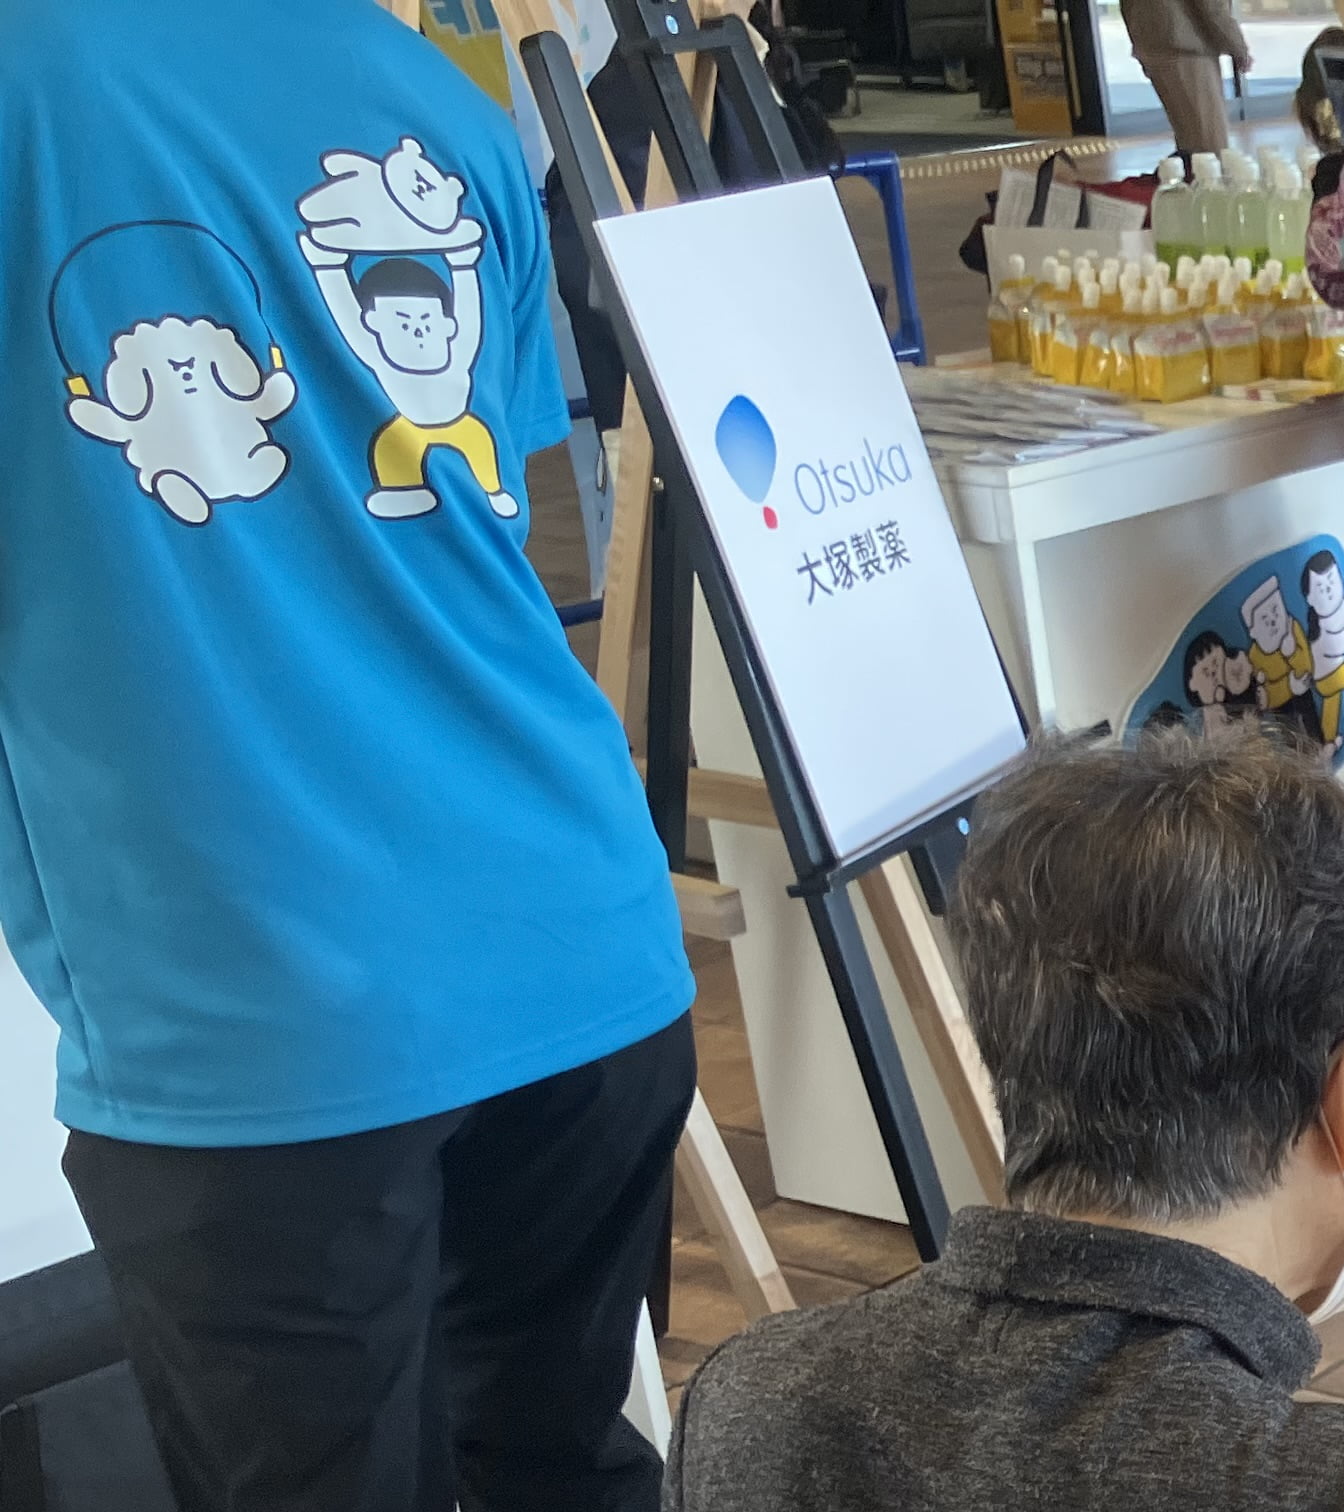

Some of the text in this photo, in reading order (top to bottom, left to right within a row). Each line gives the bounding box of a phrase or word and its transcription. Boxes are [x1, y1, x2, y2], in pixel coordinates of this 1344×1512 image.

[794, 437, 913, 516] Otsuka
[796, 519, 912, 606] 大塚製薬
